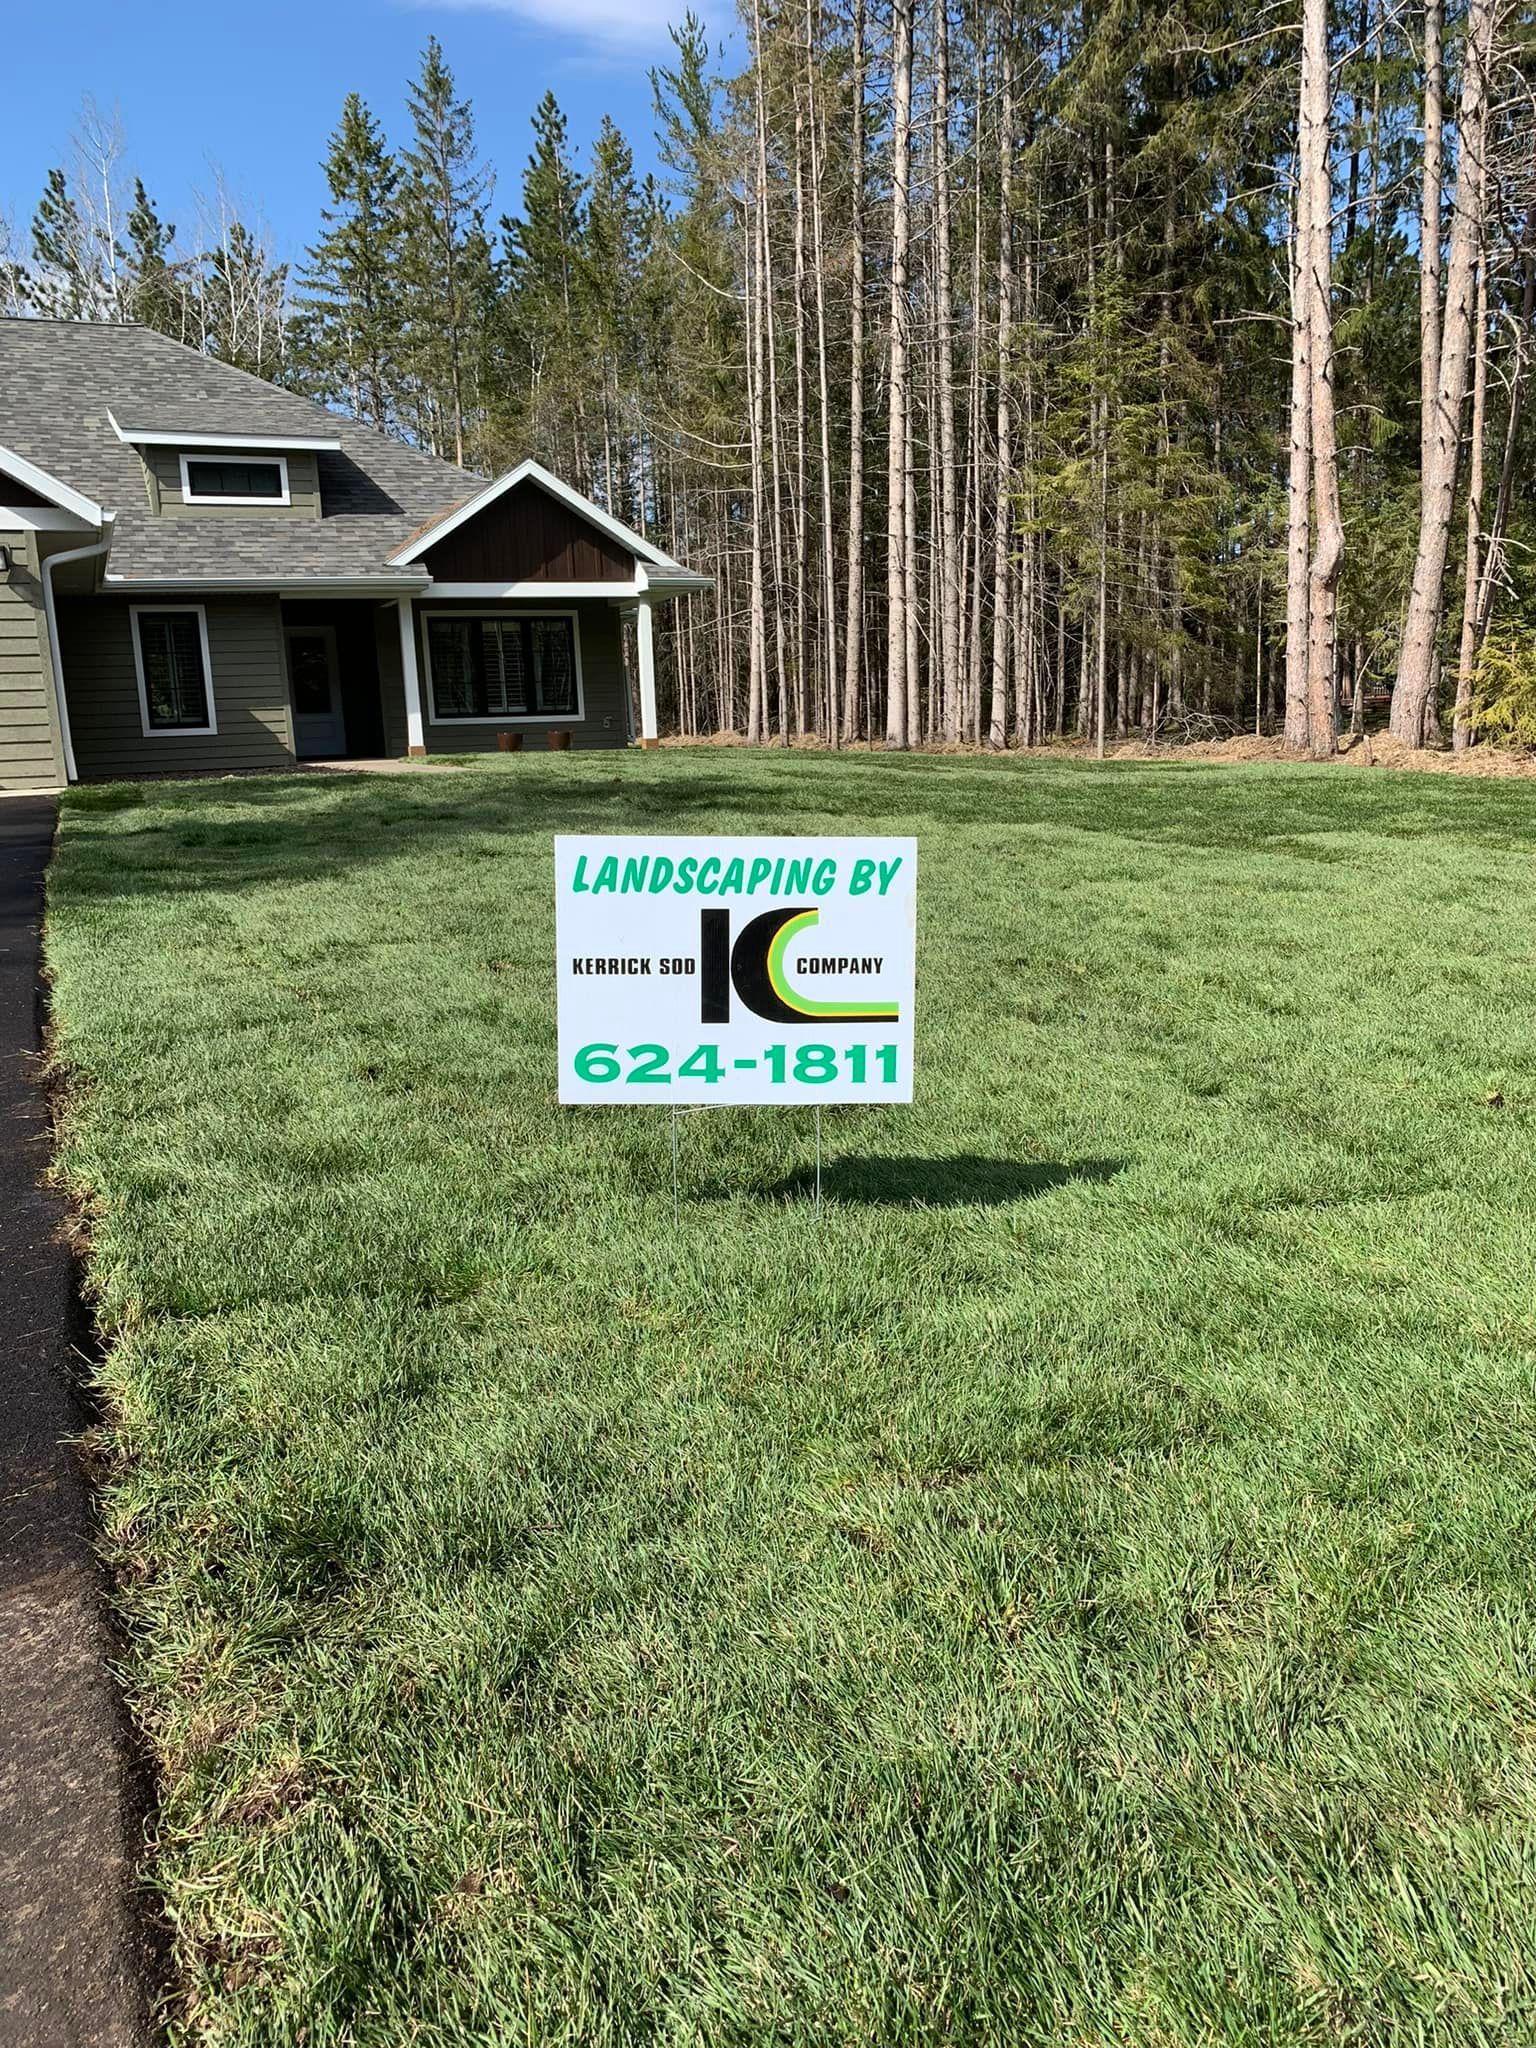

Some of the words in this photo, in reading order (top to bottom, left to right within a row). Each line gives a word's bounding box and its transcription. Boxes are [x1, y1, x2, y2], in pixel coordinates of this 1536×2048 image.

[571, 855, 837, 897] LANDSCAPING
[848, 857, 904, 897] BY
[572, 957, 652, 975] KERRICK
[659, 957, 696, 975] SOD
[796, 957, 884, 975] COMPANY
[573, 1043, 898, 1085] 624-1811
